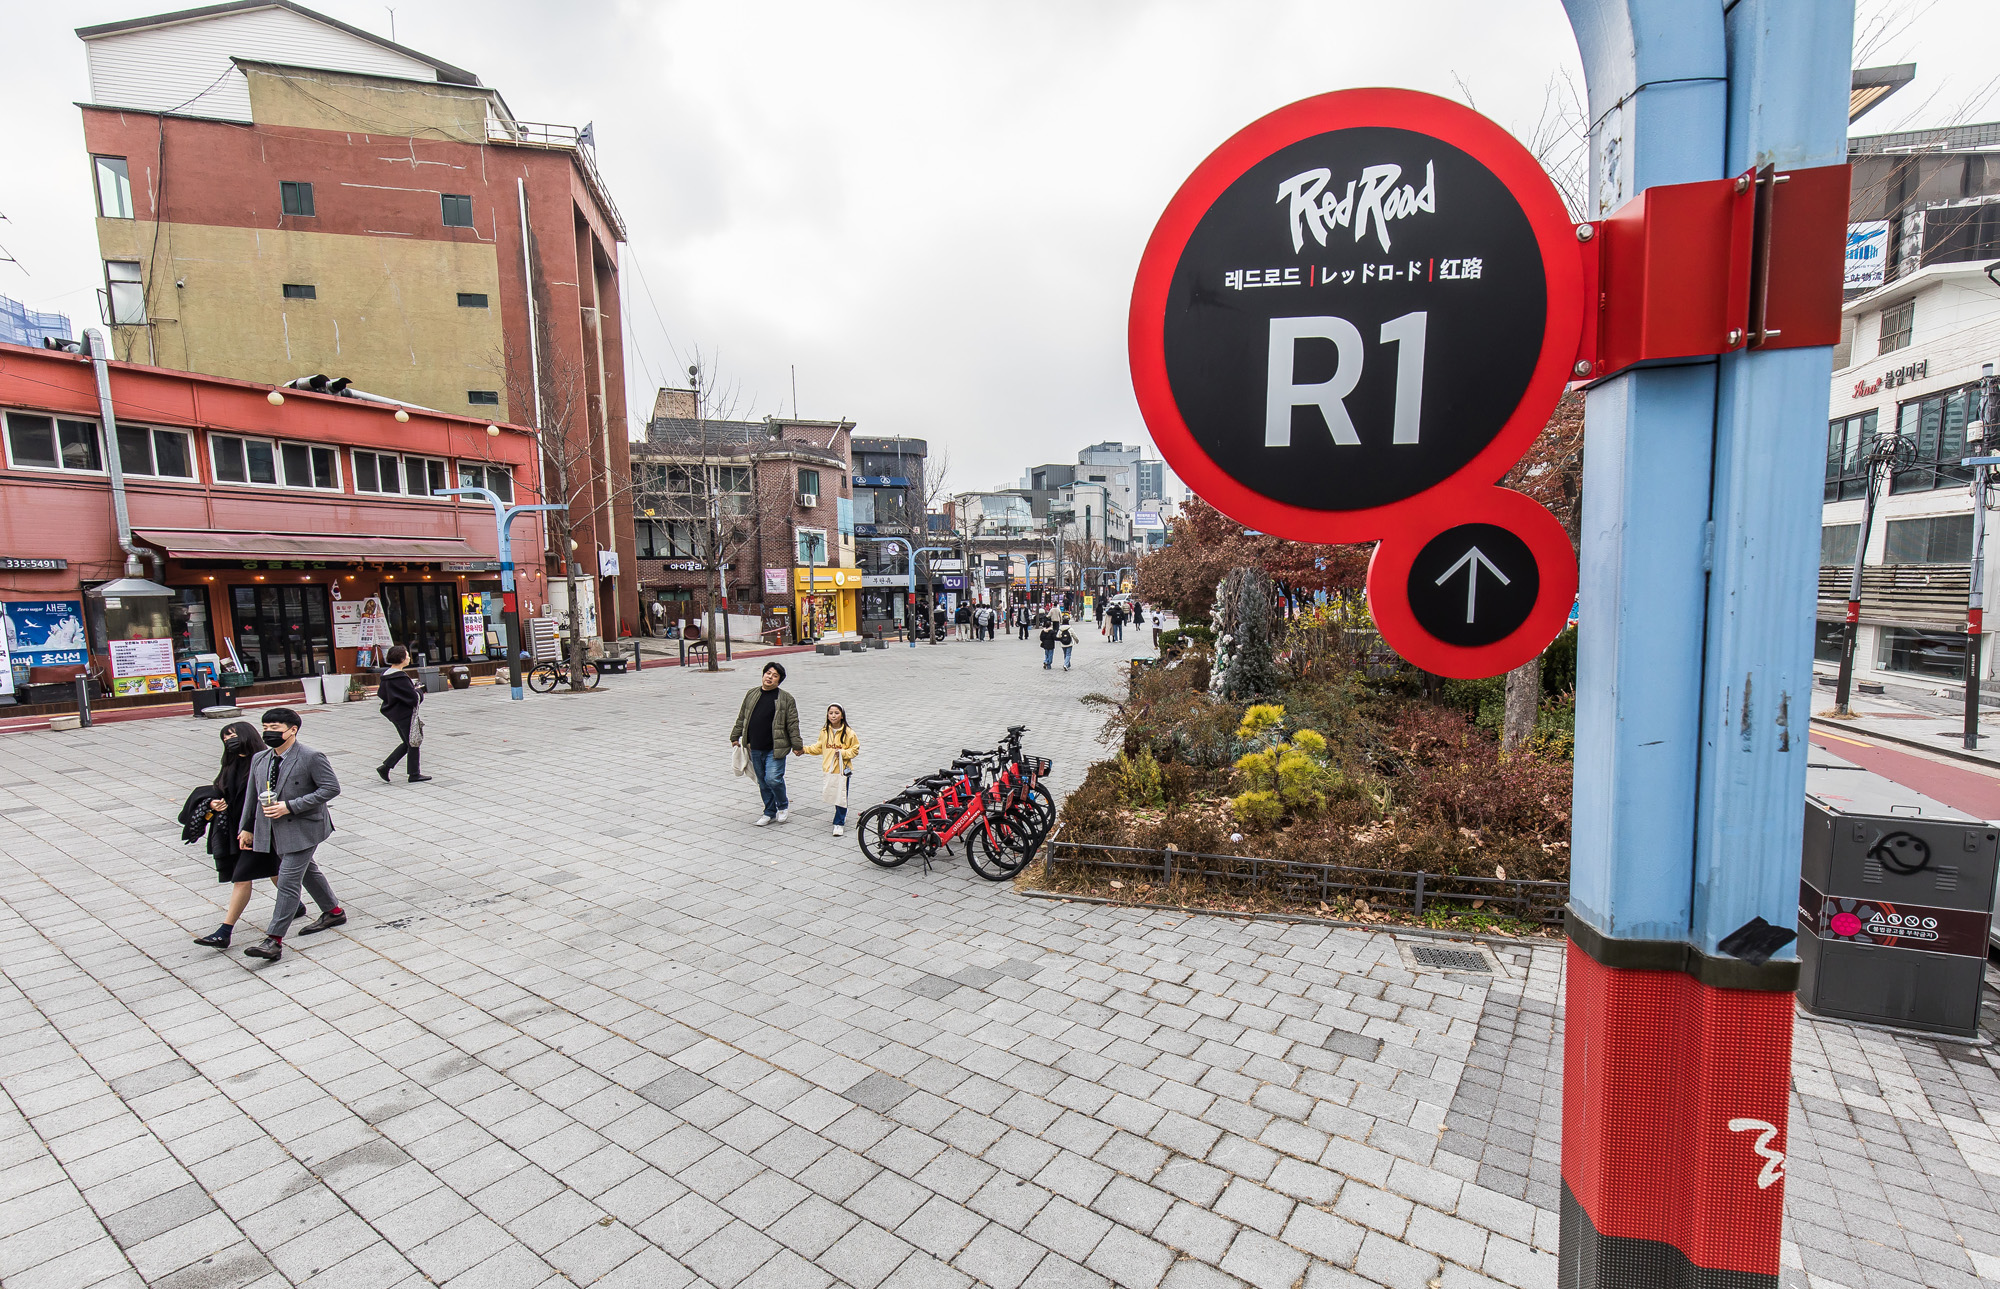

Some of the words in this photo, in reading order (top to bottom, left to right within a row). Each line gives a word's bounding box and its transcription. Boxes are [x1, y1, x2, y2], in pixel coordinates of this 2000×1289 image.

[1439, 257, 1483, 281] 红路
[1224, 267, 1302, 291] 레드로드
[1264, 311, 1428, 447] R1
[6, 559, 56, 568] 335-5491
[946, 579, 960, 587] CU
[45, 603, 67, 612] 새로
[11, 655, 34, 665] oud
[41, 652, 81, 664] 초신선
[1906, 930, 1934, 939] 부착금지
